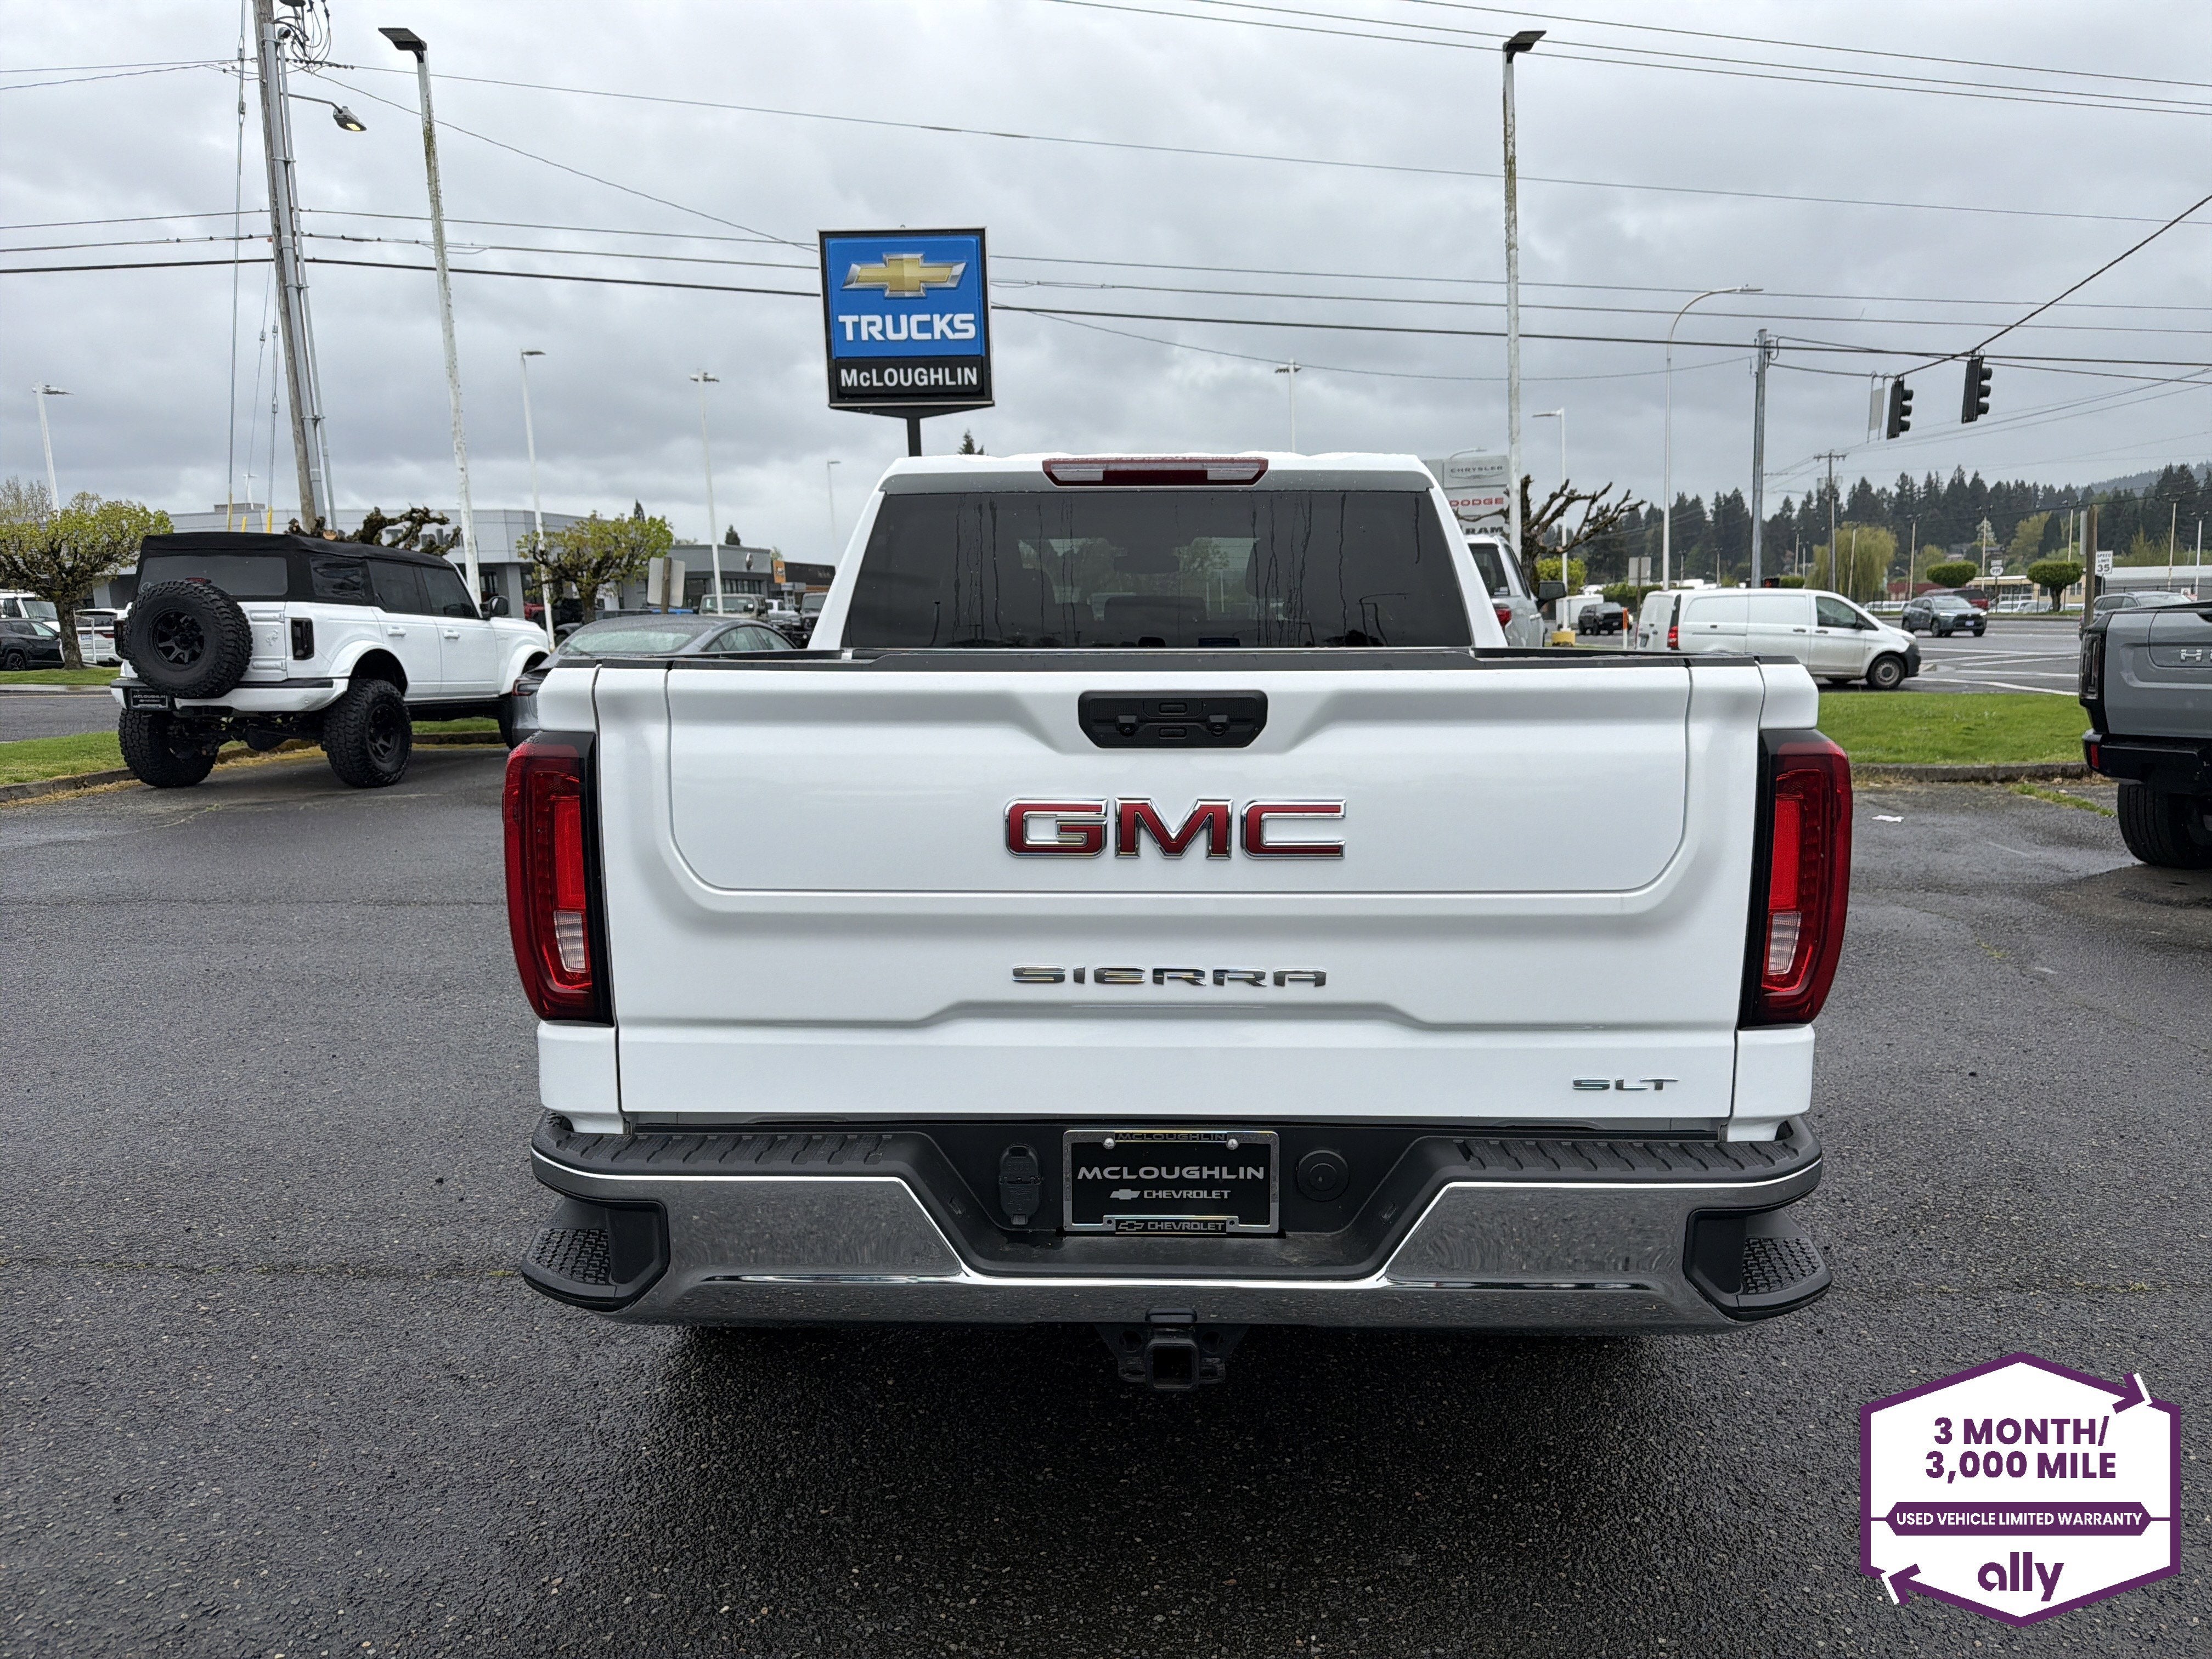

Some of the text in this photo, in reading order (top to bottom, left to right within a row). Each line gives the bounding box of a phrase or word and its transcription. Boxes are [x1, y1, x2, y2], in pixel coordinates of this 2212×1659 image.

[838, 313, 975, 341] TRUCKS
[840, 366, 977, 387] McLOUGHLIN
[1449, 497, 1504, 507] DODGE
[2097, 563, 2110, 572] 35
[1003, 798, 1346, 860] GMC
[1012, 964, 1327, 987] SIERRA
[1572, 1076, 1679, 1091] SLT
[1077, 1166, 1265, 1180] MCLOUGHLIN
[1143, 1190, 1231, 1199] CHEVROLET
[1147, 1222, 1224, 1231] CHEVROLET
